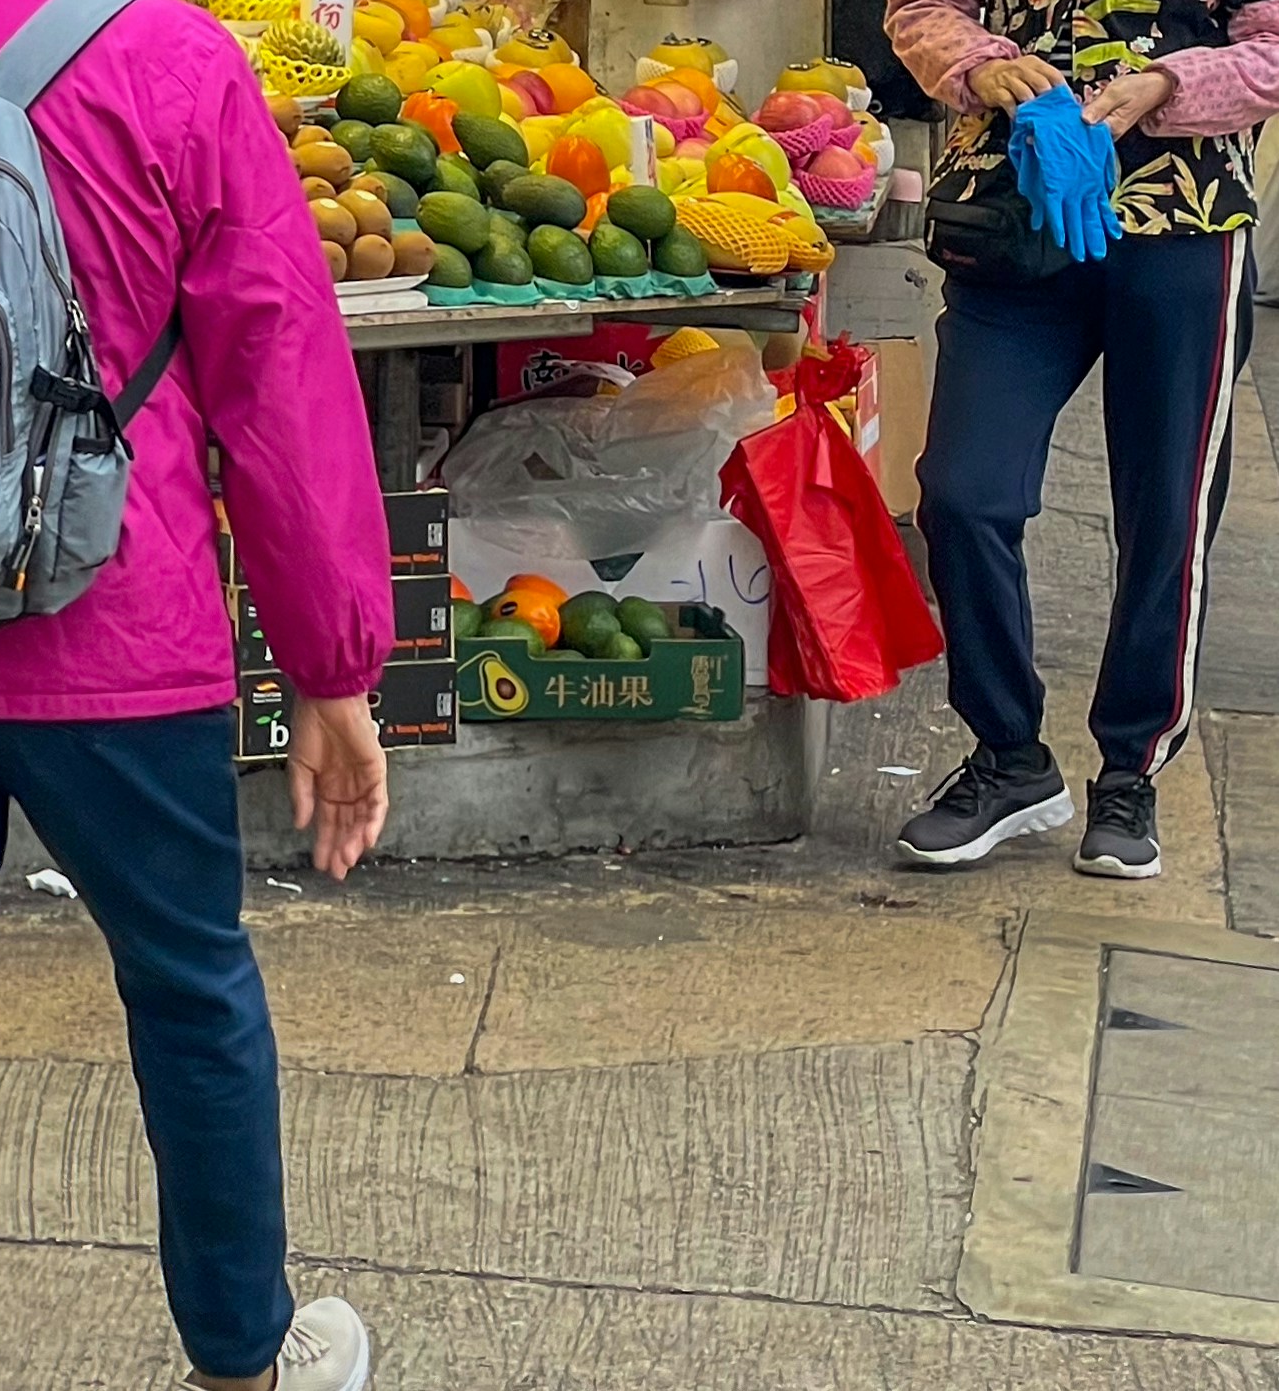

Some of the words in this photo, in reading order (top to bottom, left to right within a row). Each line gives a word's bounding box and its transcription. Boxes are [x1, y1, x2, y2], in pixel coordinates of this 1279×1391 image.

[311, 3, 344, 29] 份
[545, 674, 653, 709] 牛油果
